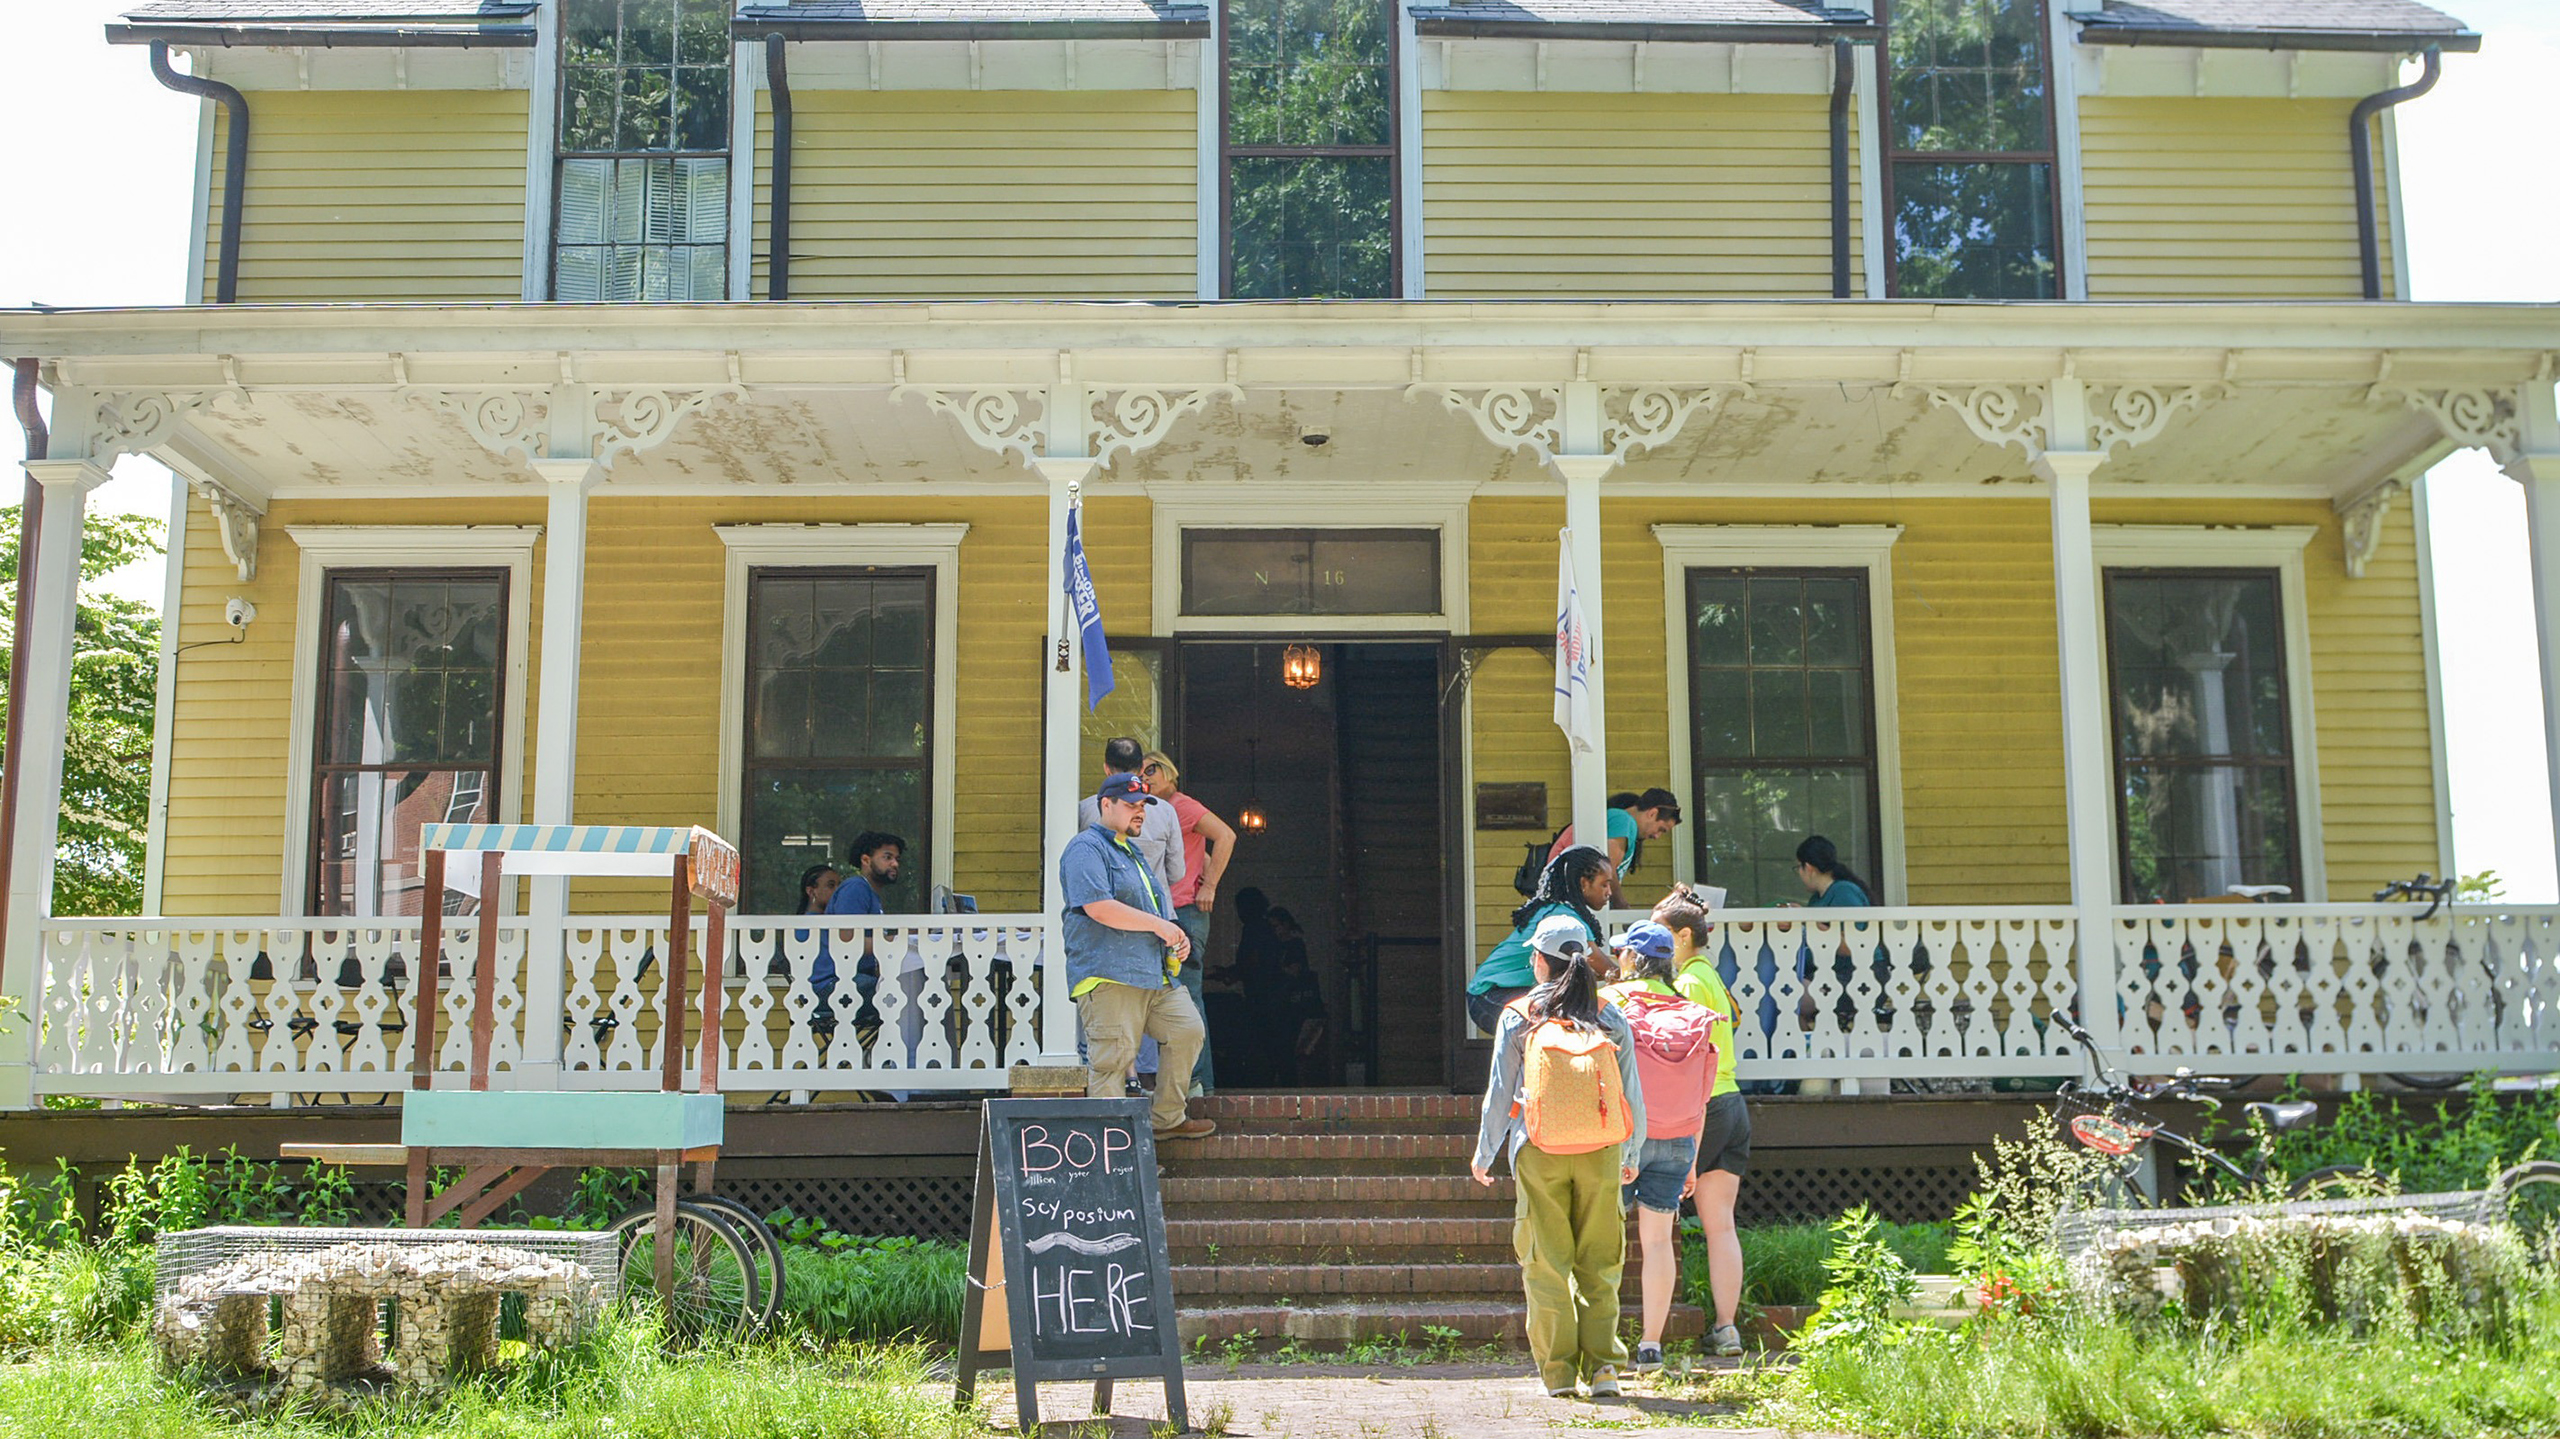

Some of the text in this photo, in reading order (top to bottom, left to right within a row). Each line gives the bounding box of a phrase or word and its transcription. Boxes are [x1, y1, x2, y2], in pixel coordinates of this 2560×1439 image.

[1075, 554, 1096, 601] BILION
[1324, 570, 1344, 586] 16
[1020, 1124, 1132, 1178] BOP
[1068, 1171, 1091, 1184] yster
[1032, 1262, 1154, 1339] HERE
